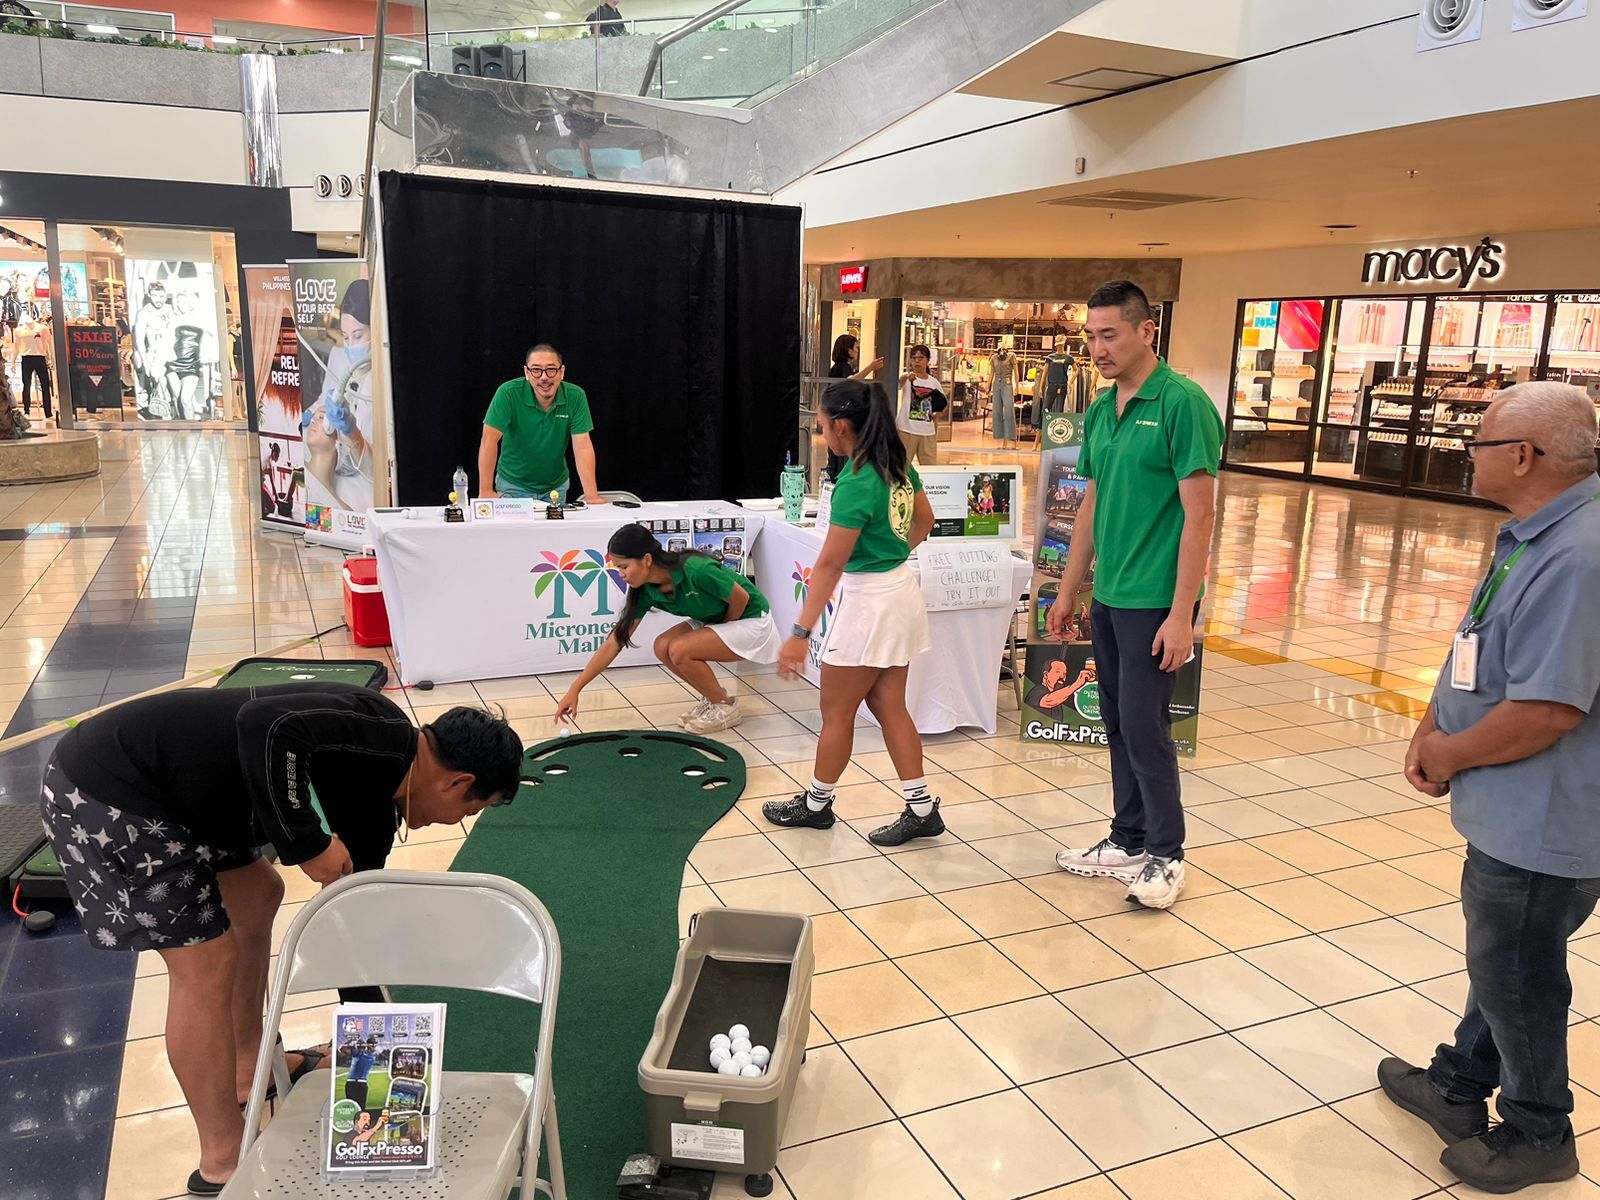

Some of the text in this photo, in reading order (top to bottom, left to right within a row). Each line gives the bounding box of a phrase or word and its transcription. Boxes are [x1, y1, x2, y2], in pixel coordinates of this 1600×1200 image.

[295, 278, 337, 302] LOVE
[296, 303, 336, 313] YOUR BEST
[297, 313, 314, 323] SELF
[73, 331, 112, 343] SALE
[280, 355, 300, 370] REL
[271, 371, 300, 387] REFRE
[347, 514, 366, 526] LOVE
[927, 550, 998, 566] FREE PUTTING
[940, 569, 996, 585] CHALLENGE!
[946, 585, 1001, 600] TRY IT OUT
[1027, 721, 1109, 745] GolFxPre
[335, 1141, 423, 1156] GolFxPresso
